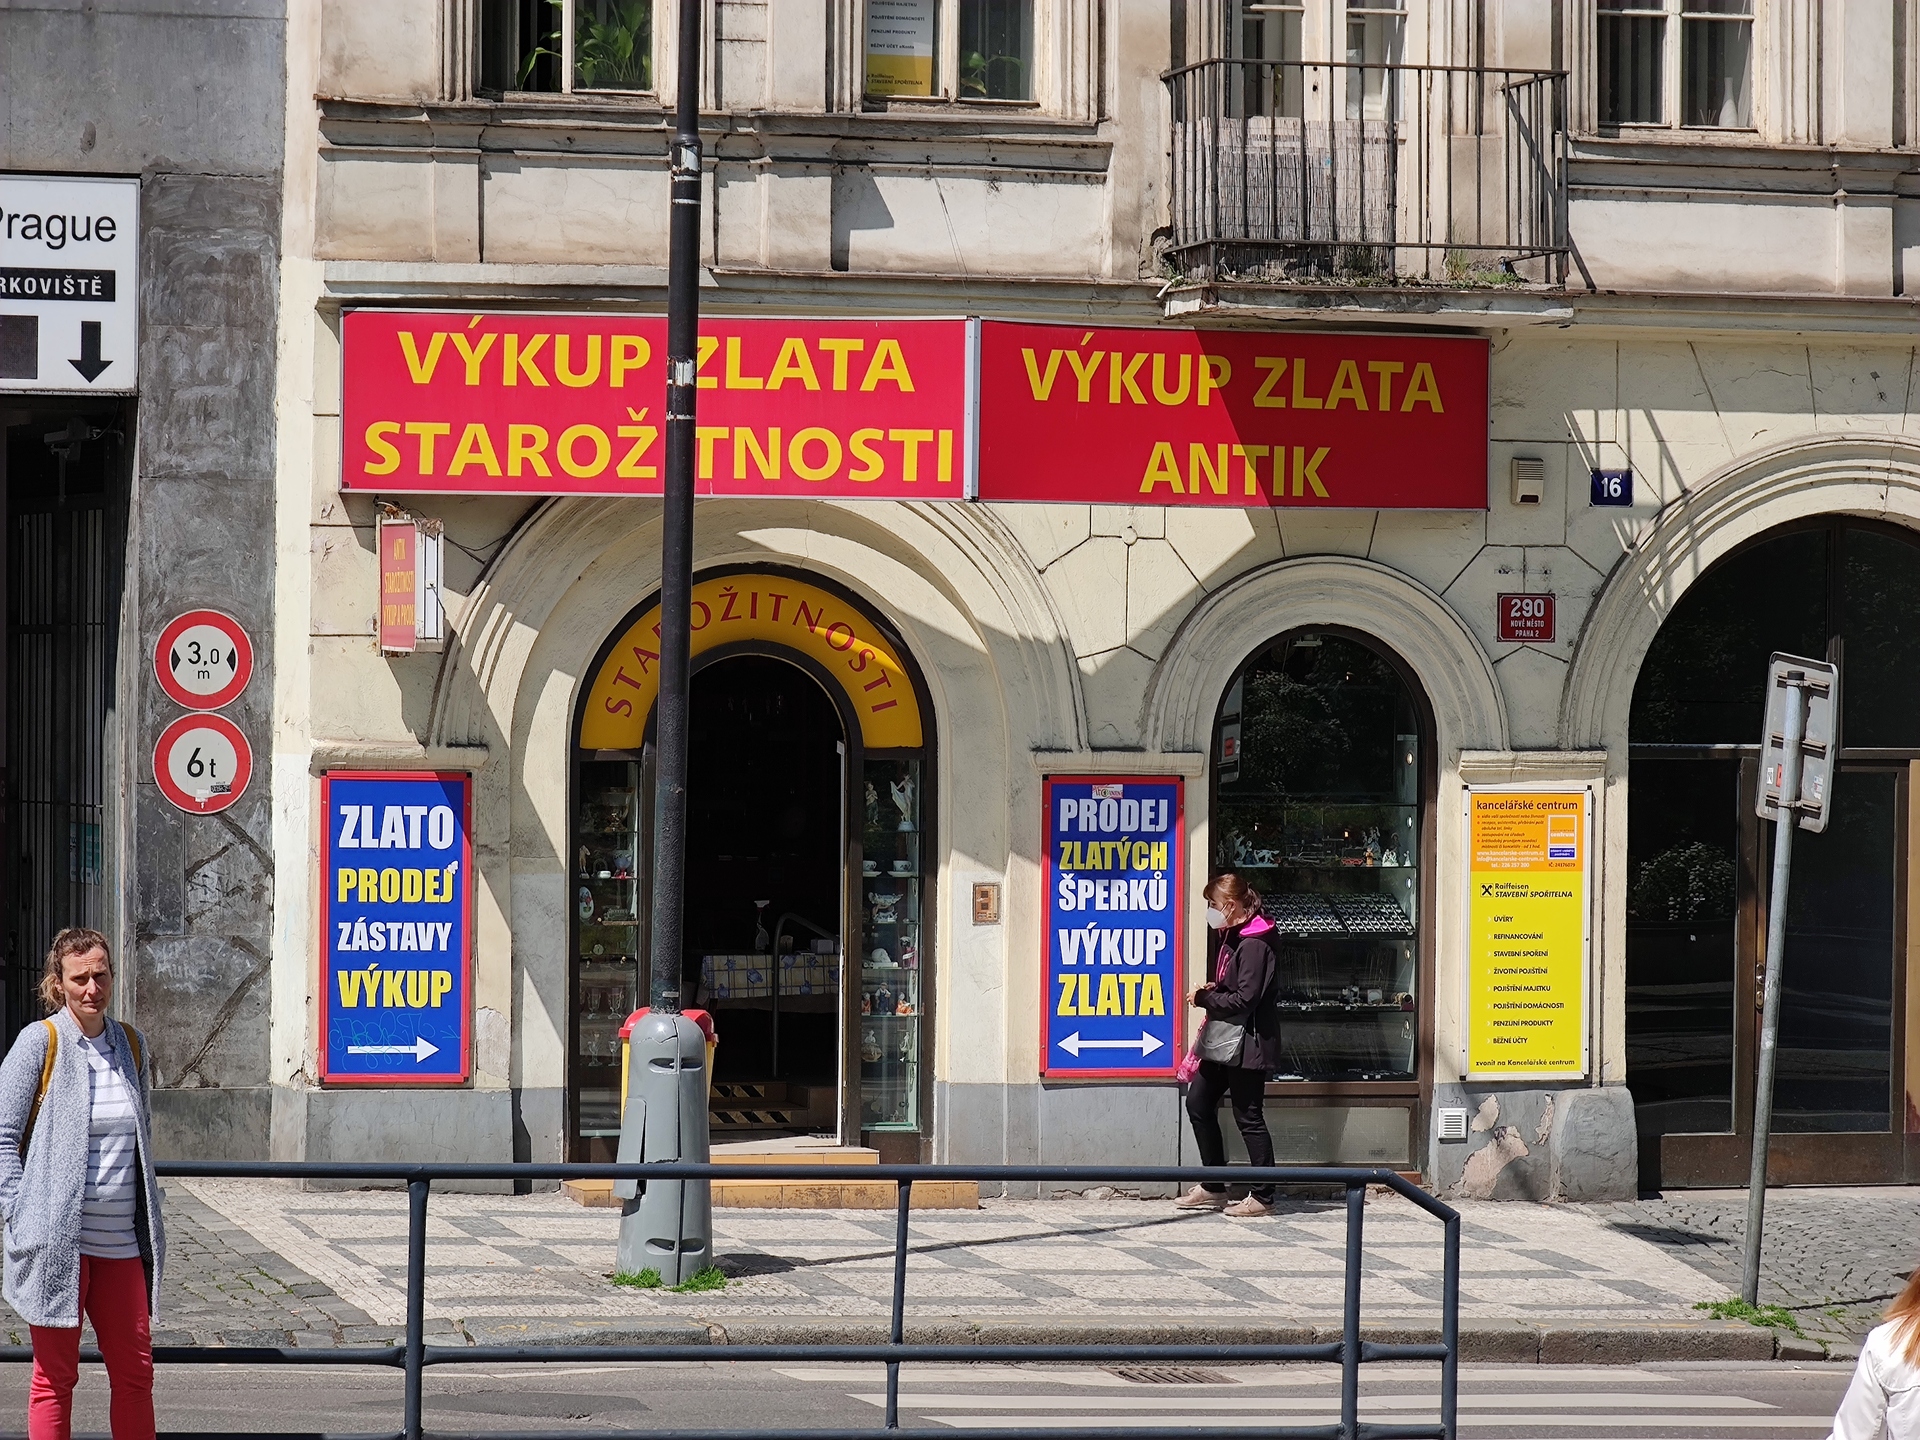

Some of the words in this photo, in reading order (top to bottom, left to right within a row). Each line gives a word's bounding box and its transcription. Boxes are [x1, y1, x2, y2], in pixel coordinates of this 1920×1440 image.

[0, 206, 117, 250] rague
[397, 315, 651, 388] VÝKUP
[1022, 332, 1232, 407] VÝKUP
[1253, 356, 1444, 414] ZLATA
[363, 407, 953, 483] STAROŽTNOSTI
[1139, 441, 1331, 498] ANTIK
[1601, 477, 1622, 498] 16
[1510, 598, 1545, 618] 290
[1510, 618, 1525, 628] NOVÉ
[1526, 618, 1545, 628] MĚSTO
[1515, 629, 1533, 637] PRAHA
[1535, 629, 1539, 637] 2
[187, 641, 220, 666] 3,0
[604, 585, 898, 718] STAOŽITNOSTI
[197, 669, 210, 679] m
[187, 748, 204, 778] 6
[210, 759, 216, 777] t
[1059, 799, 1168, 832] PRODEJ
[1477, 800, 1534, 810] kancelářské
[1536, 802, 1578, 810] centrum
[339, 805, 455, 850] ZLATO
[1059, 836, 1168, 870] ZLATÝCH
[338, 868, 454, 903] PRODEJ
[1058, 871, 1167, 911] ŠPERKŮ
[1495, 890, 1528, 898] STAVEBNÍ
[1530, 890, 1573, 898] SPOŘITELNA
[338, 916, 452, 952] ZÁSTAVY
[1058, 922, 1167, 965] VÝKUP
[337, 963, 452, 1008] VÝKUP
[1057, 973, 1165, 1016] ZLATA
